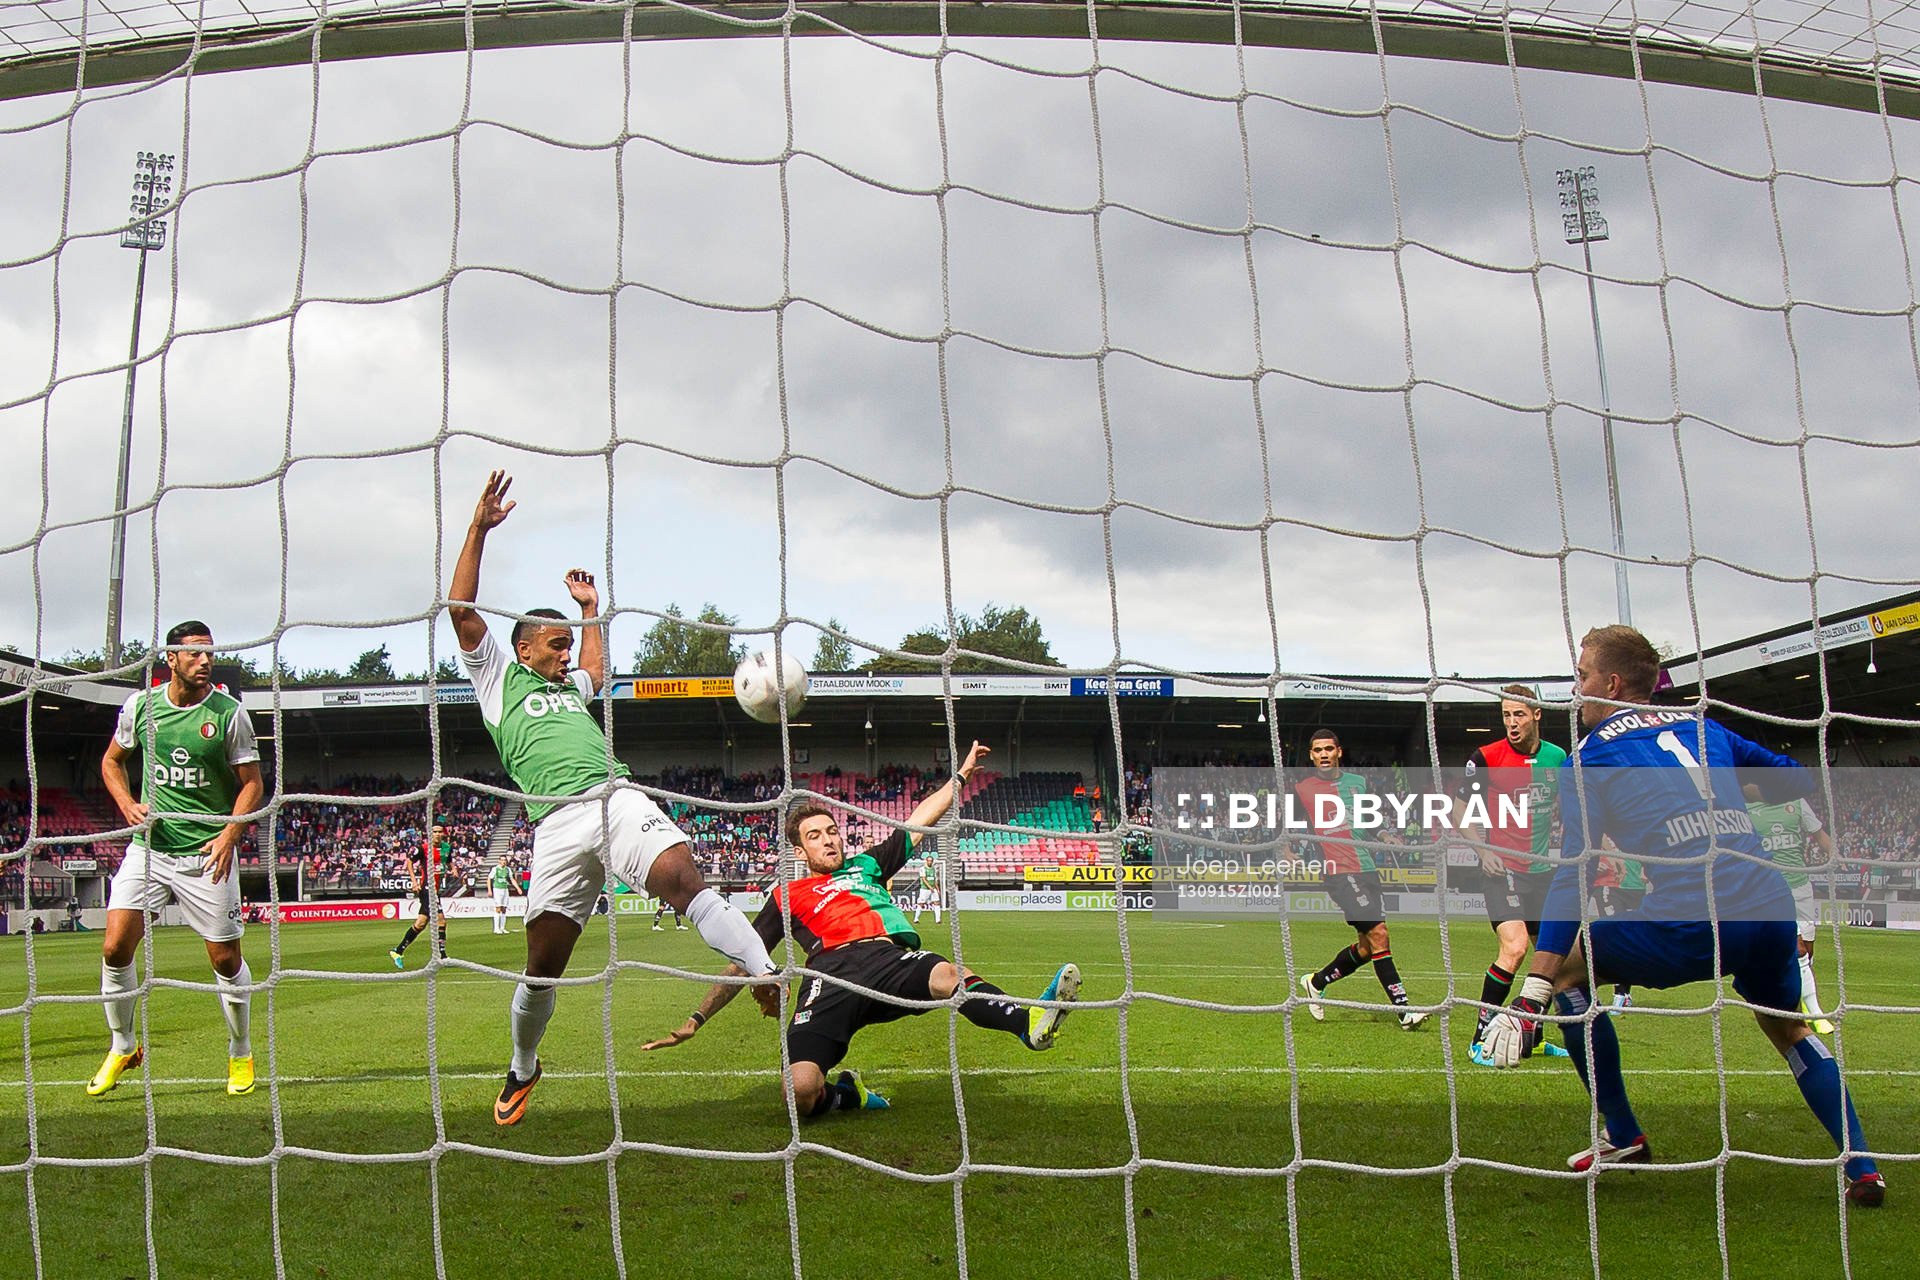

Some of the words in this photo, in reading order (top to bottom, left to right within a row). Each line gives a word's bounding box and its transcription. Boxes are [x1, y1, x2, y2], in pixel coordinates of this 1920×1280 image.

[1898, 613, 1919, 626] DALEN
[636, 681, 688, 693] Linnartz
[813, 680, 864, 688] STAALBOUW
[866, 680, 891, 688] MOOK
[892, 680, 903, 688] BV
[1085, 679, 1109, 689] Kees
[1113, 680, 1133, 689] van
[1136, 679, 1161, 690] Gent
[524, 692, 588, 718] OPEL
[1656, 730, 1717, 800] 1
[154, 764, 211, 789] OPEL
[1761, 833, 1802, 851] OPEL
[1072, 868, 1126, 880] AUTO
[975, 893, 1062, 906] shiningplaces
[1072, 893, 1157, 909] antonio
[290, 908, 378, 918] ORIENTPLAZA.COM
